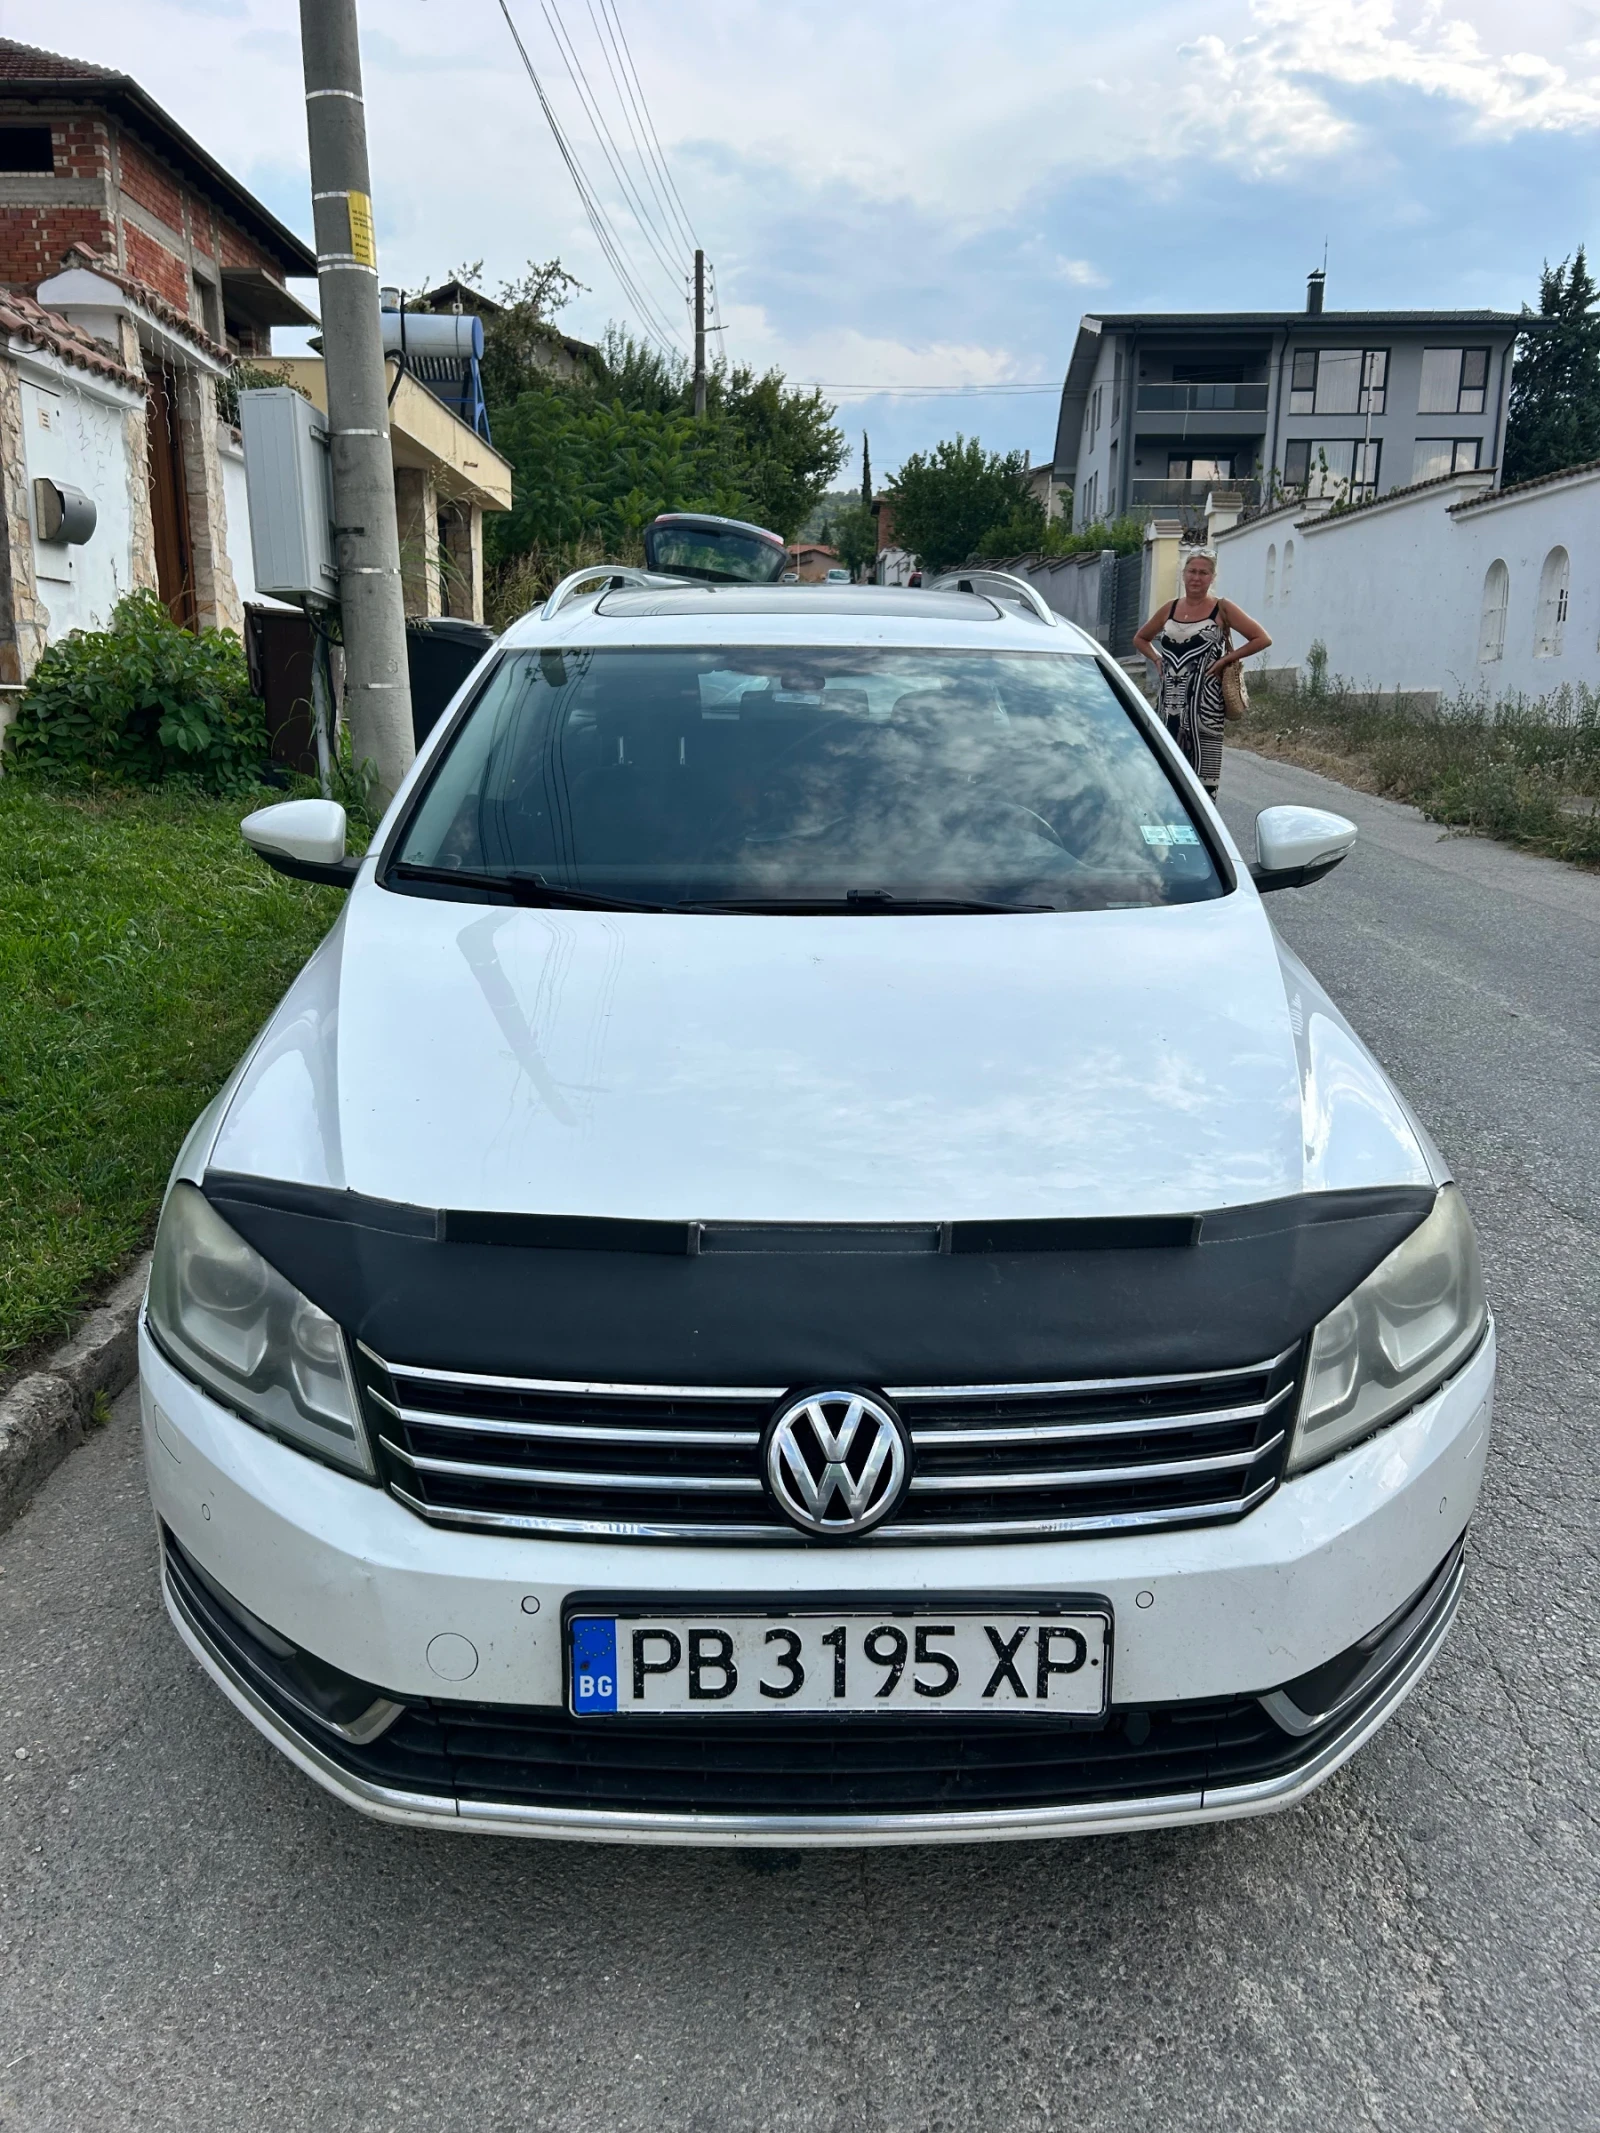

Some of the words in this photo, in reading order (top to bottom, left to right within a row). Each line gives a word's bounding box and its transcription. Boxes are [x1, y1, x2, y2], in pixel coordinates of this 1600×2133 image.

[768, 1391, 904, 1533] VW
[579, 1675, 613, 1698] BG
[632, 1628, 738, 1700] PB
[759, 1625, 960, 1699] 3195
[981, 1625, 1088, 1699] XP
